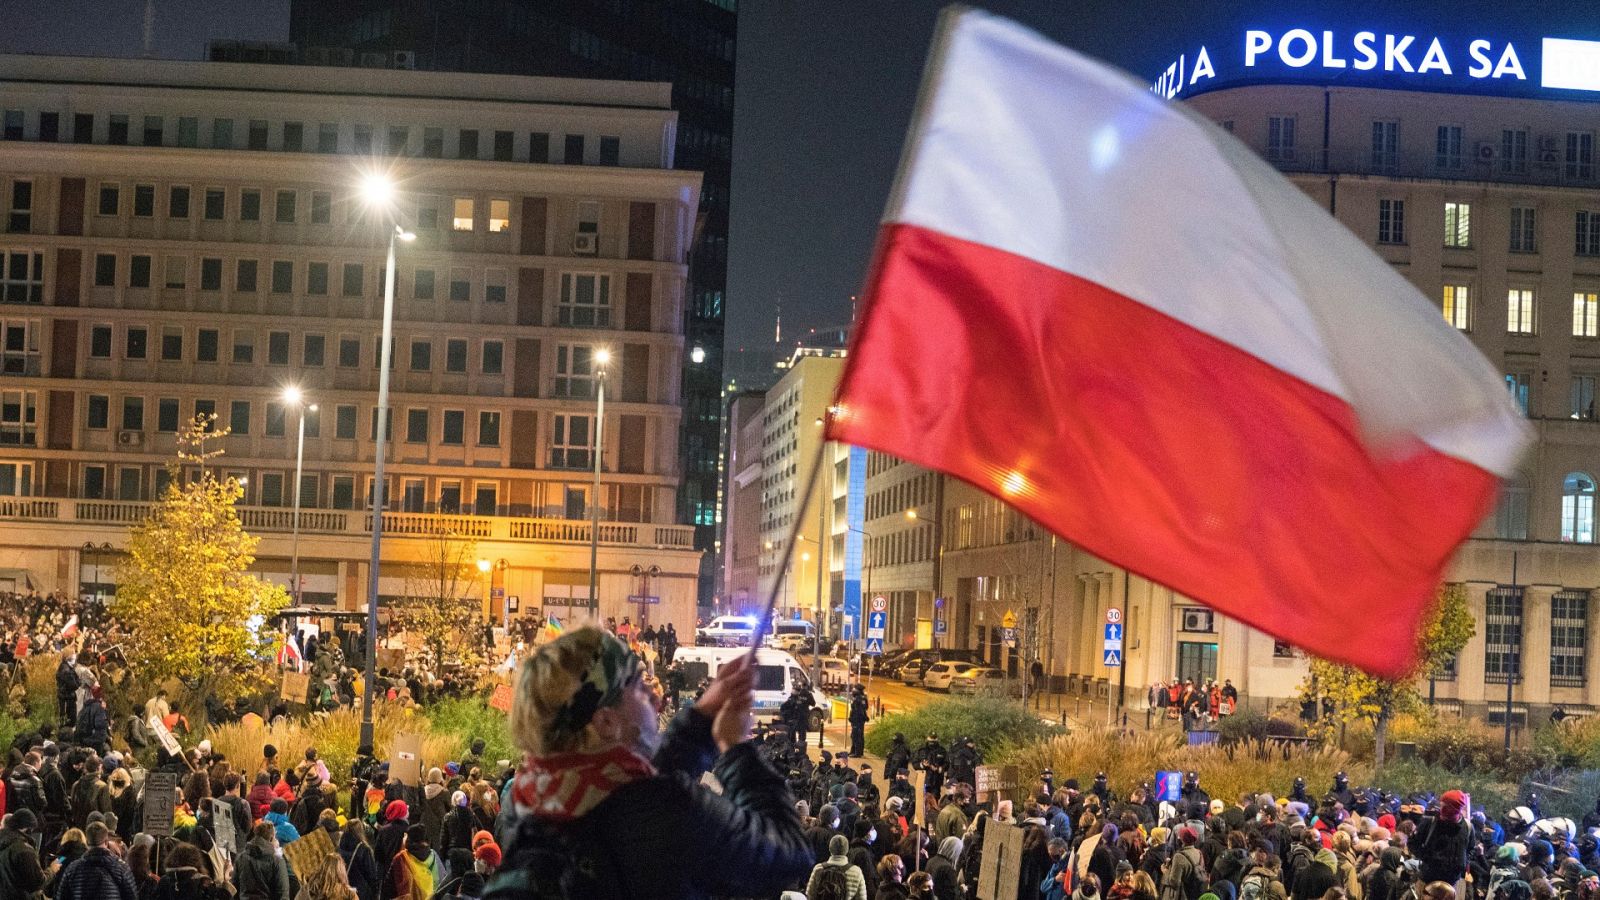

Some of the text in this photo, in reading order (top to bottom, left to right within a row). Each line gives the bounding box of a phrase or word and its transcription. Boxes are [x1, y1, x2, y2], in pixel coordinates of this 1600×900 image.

[1245, 28, 1452, 75] POLSKA
[1469, 39, 1527, 80] SA
[874, 600, 885, 608] 30
[1108, 611, 1120, 620] 30
[937, 622, 945, 631] P
